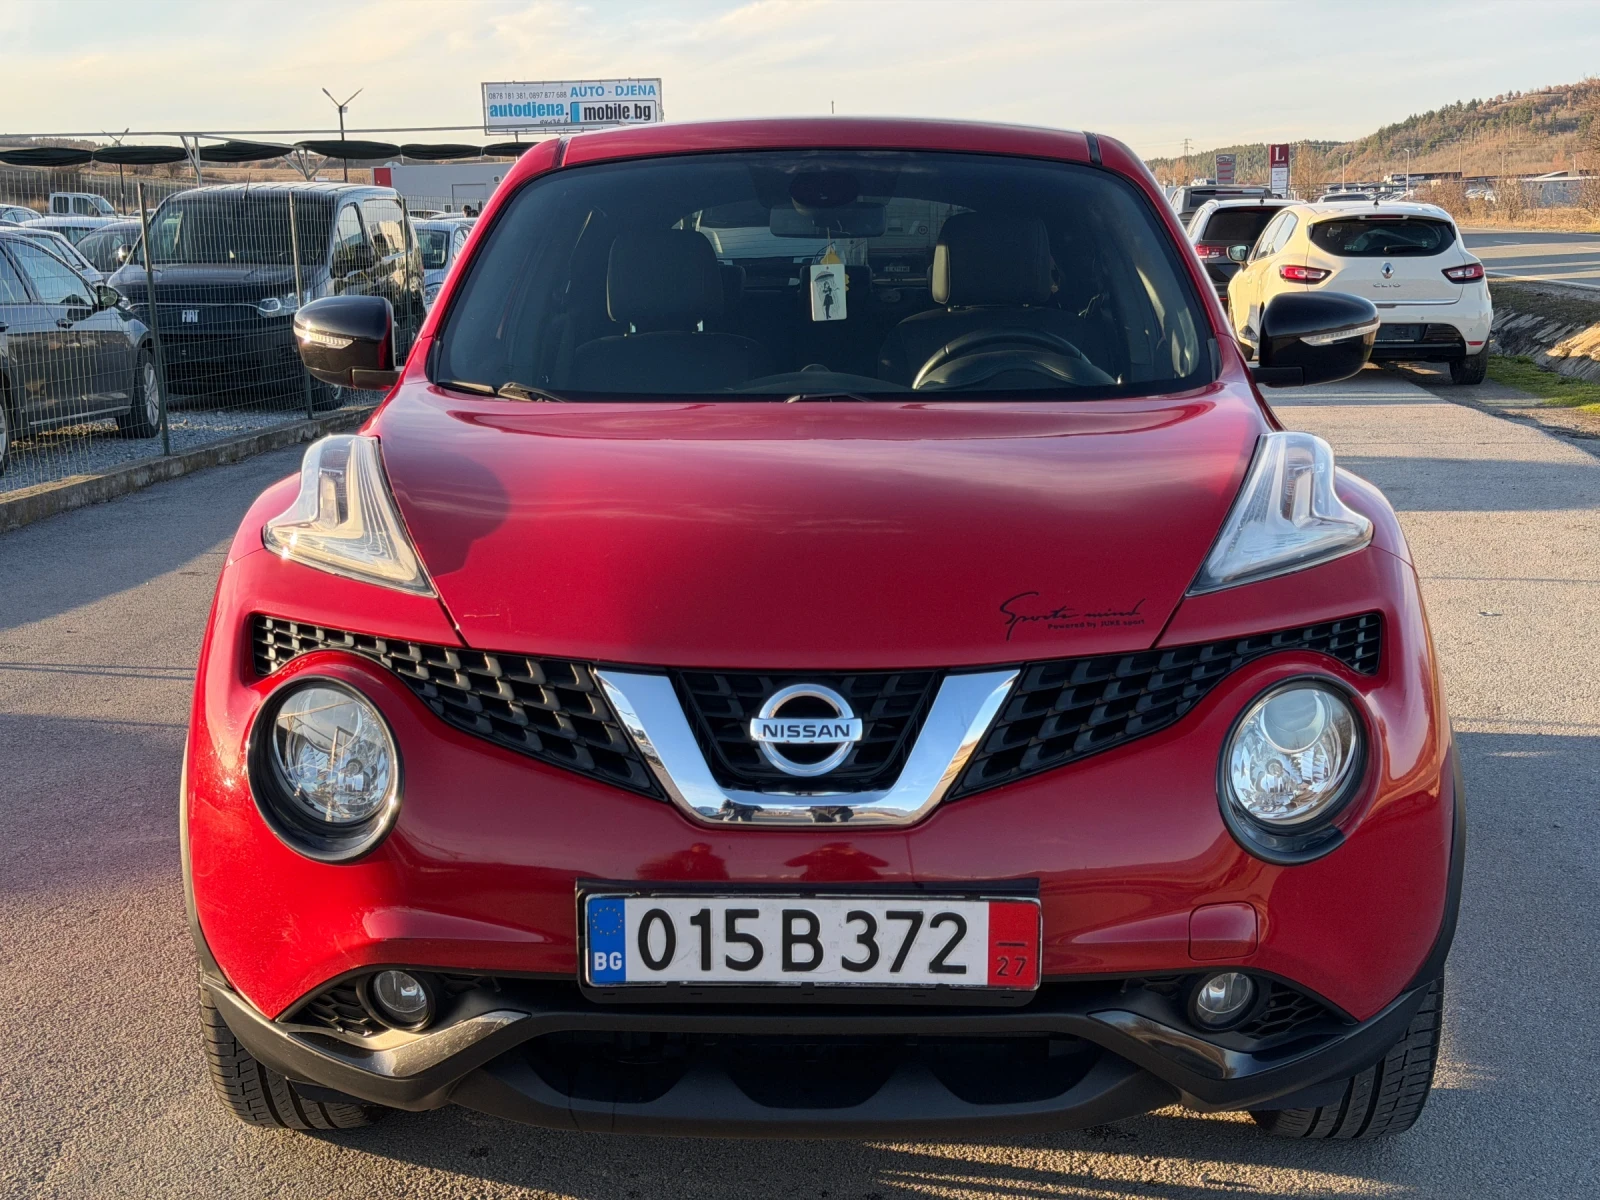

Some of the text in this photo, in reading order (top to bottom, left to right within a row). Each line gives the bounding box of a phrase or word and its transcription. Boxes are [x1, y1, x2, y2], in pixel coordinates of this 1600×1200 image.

[570, 86, 604, 97] AUTO
[615, 85, 656, 96] DJENA
[583, 103, 651, 121] mobile.bg
[1275, 146, 1285, 161] L
[182, 310, 199, 323] FIAT
[1084, 598, 1146, 618] mind
[1047, 621, 1085, 630] Powered
[1087, 621, 1097, 629] by
[763, 724, 849, 738] NISSAN
[594, 952, 622, 971] BG
[996, 956, 1027, 976] 27
